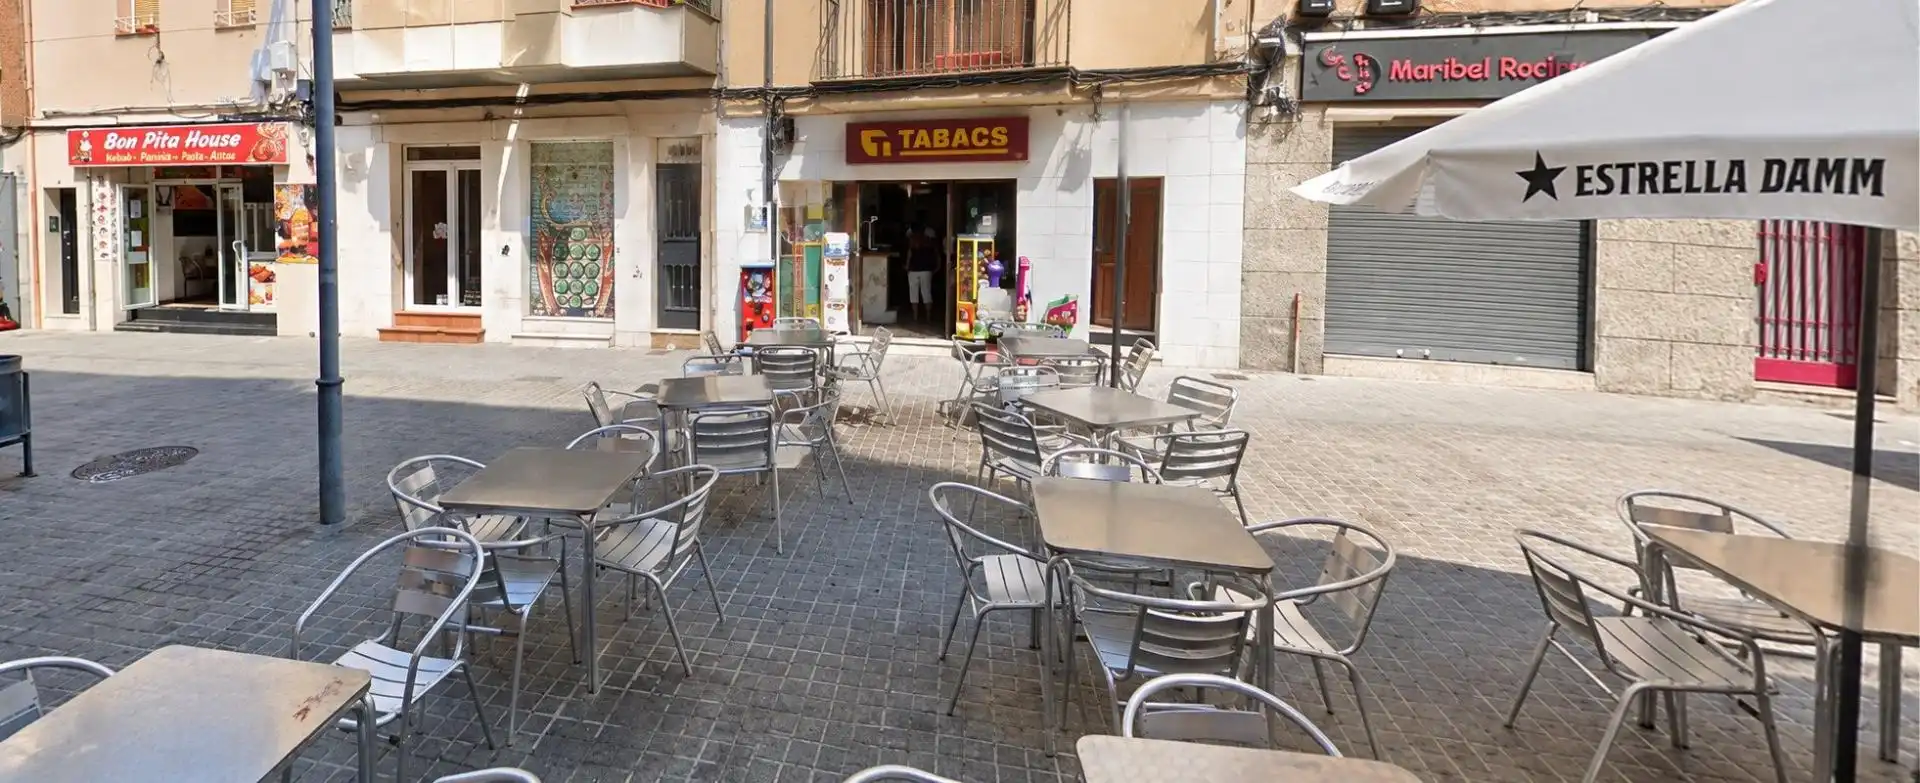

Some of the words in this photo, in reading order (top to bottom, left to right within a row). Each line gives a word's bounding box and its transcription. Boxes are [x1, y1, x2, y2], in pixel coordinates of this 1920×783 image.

[1389, 57, 1490, 81] Maribel
[104, 132, 138, 150] Bon
[142, 131, 180, 149] Pita
[185, 130, 242, 148] House
[898, 126, 1009, 149] TABACS
[1575, 159, 1748, 197] ESTRELLA
[1760, 157, 1886, 197] DAMM
